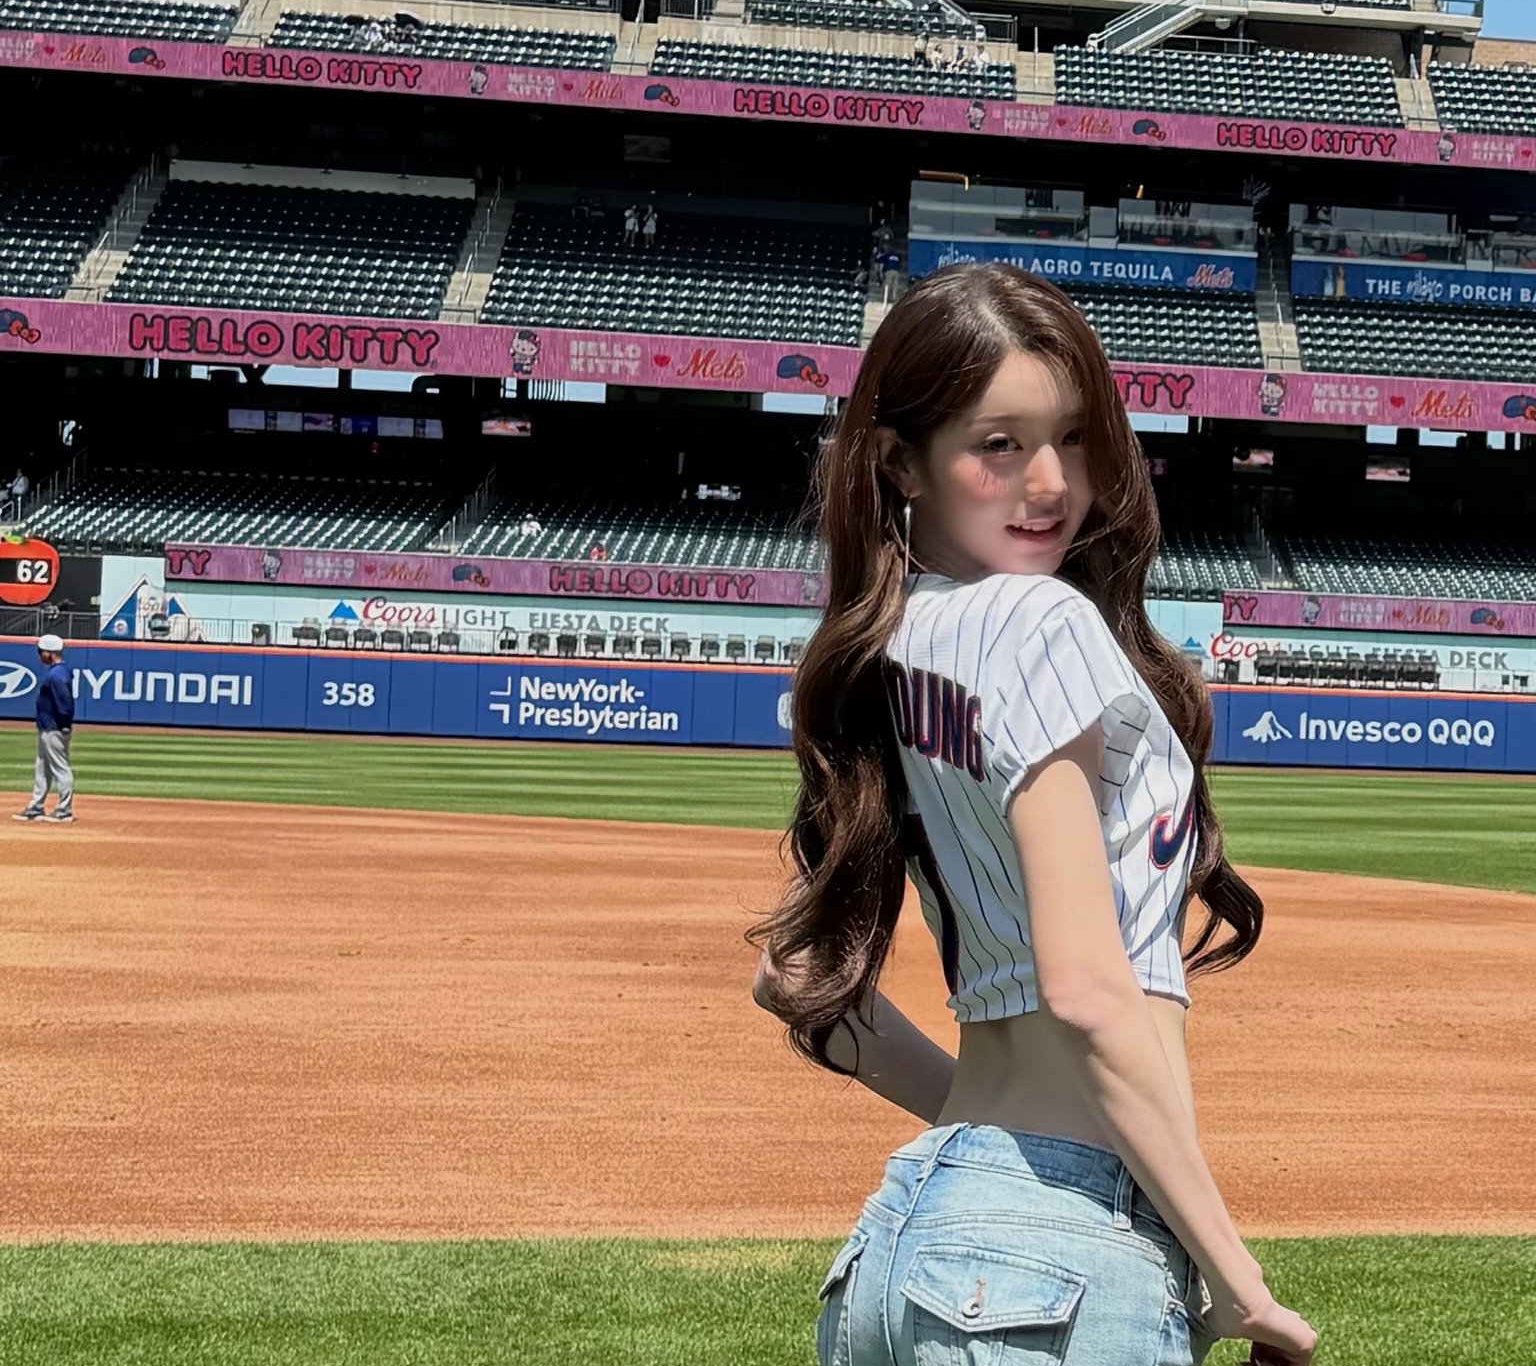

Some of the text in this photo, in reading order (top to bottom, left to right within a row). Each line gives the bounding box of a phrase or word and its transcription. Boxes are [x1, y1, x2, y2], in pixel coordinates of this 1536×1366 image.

[222, 51, 422, 88] HELLO KITTY
[734, 89, 924, 125] HELLO KITTY
[1217, 122, 1397, 157] HELLO KITTY
[1090, 262, 1174, 281] TEQUILA
[1366, 279, 1401, 295] THE
[1450, 285, 1512, 302] PORCH
[130, 312, 441, 365] HELLO KITTY
[677, 347, 748, 380] Mets
[1411, 389, 1476, 420] Mets
[17, 559, 49, 583] 62
[549, 566, 755, 599] HELLO KITTY
[361, 596, 436, 623] Coors
[609, 615, 670, 633] DECK
[1451, 650, 1508, 670] DECK
[72, 668, 253, 706] YUNDAI
[322, 681, 376, 707] 358
[520, 676, 644, 704] NewYork-
[518, 701, 679, 735] Presbyterian
[1299, 712, 1495, 748] Invesco QQQ
